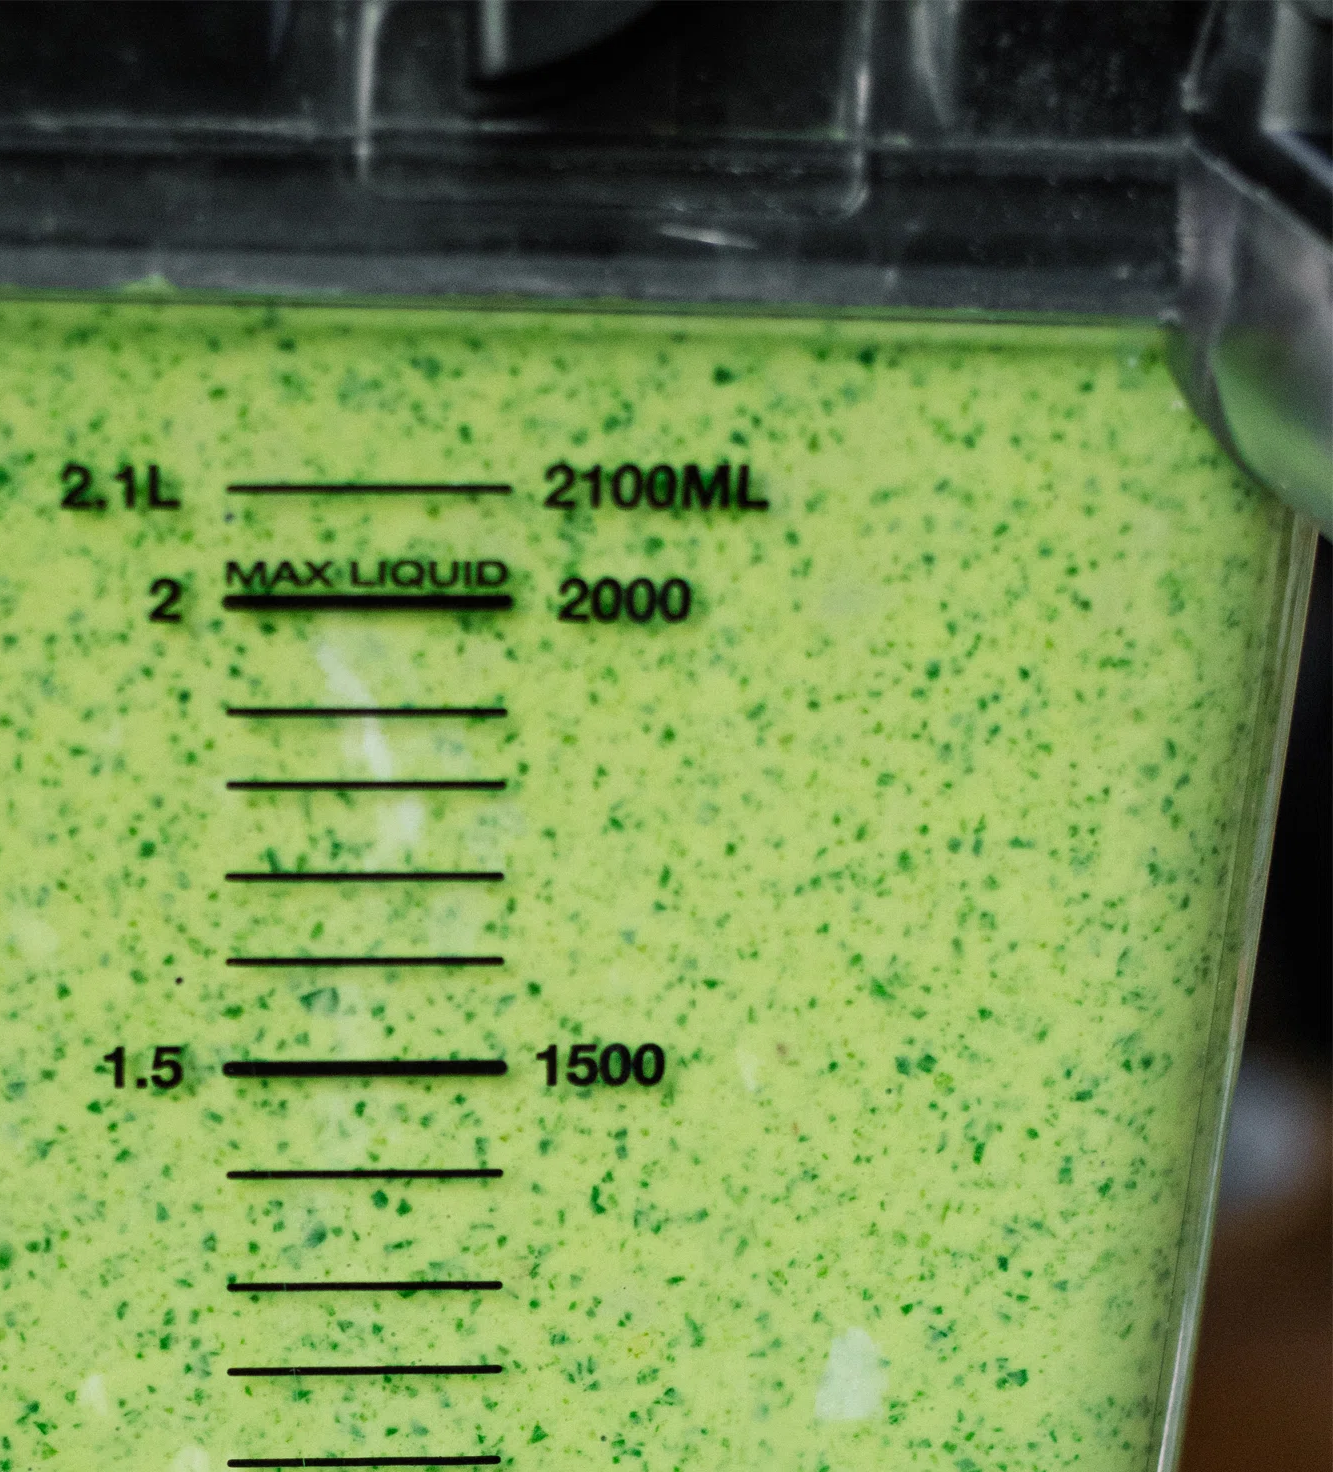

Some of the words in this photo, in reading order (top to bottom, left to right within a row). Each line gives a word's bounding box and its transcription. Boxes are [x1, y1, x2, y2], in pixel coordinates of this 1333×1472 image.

[60, 465, 182, 510] 2.1L
[543, 464, 770, 510] 2100ML
[226, 561, 333, 587] MAX
[350, 559, 510, 587] LIQUID
[148, 581, 183, 622] 2
[558, 578, 692, 622] 2000
[104, 1047, 184, 1089] 1.5
[536, 1043, 666, 1087] 1500
